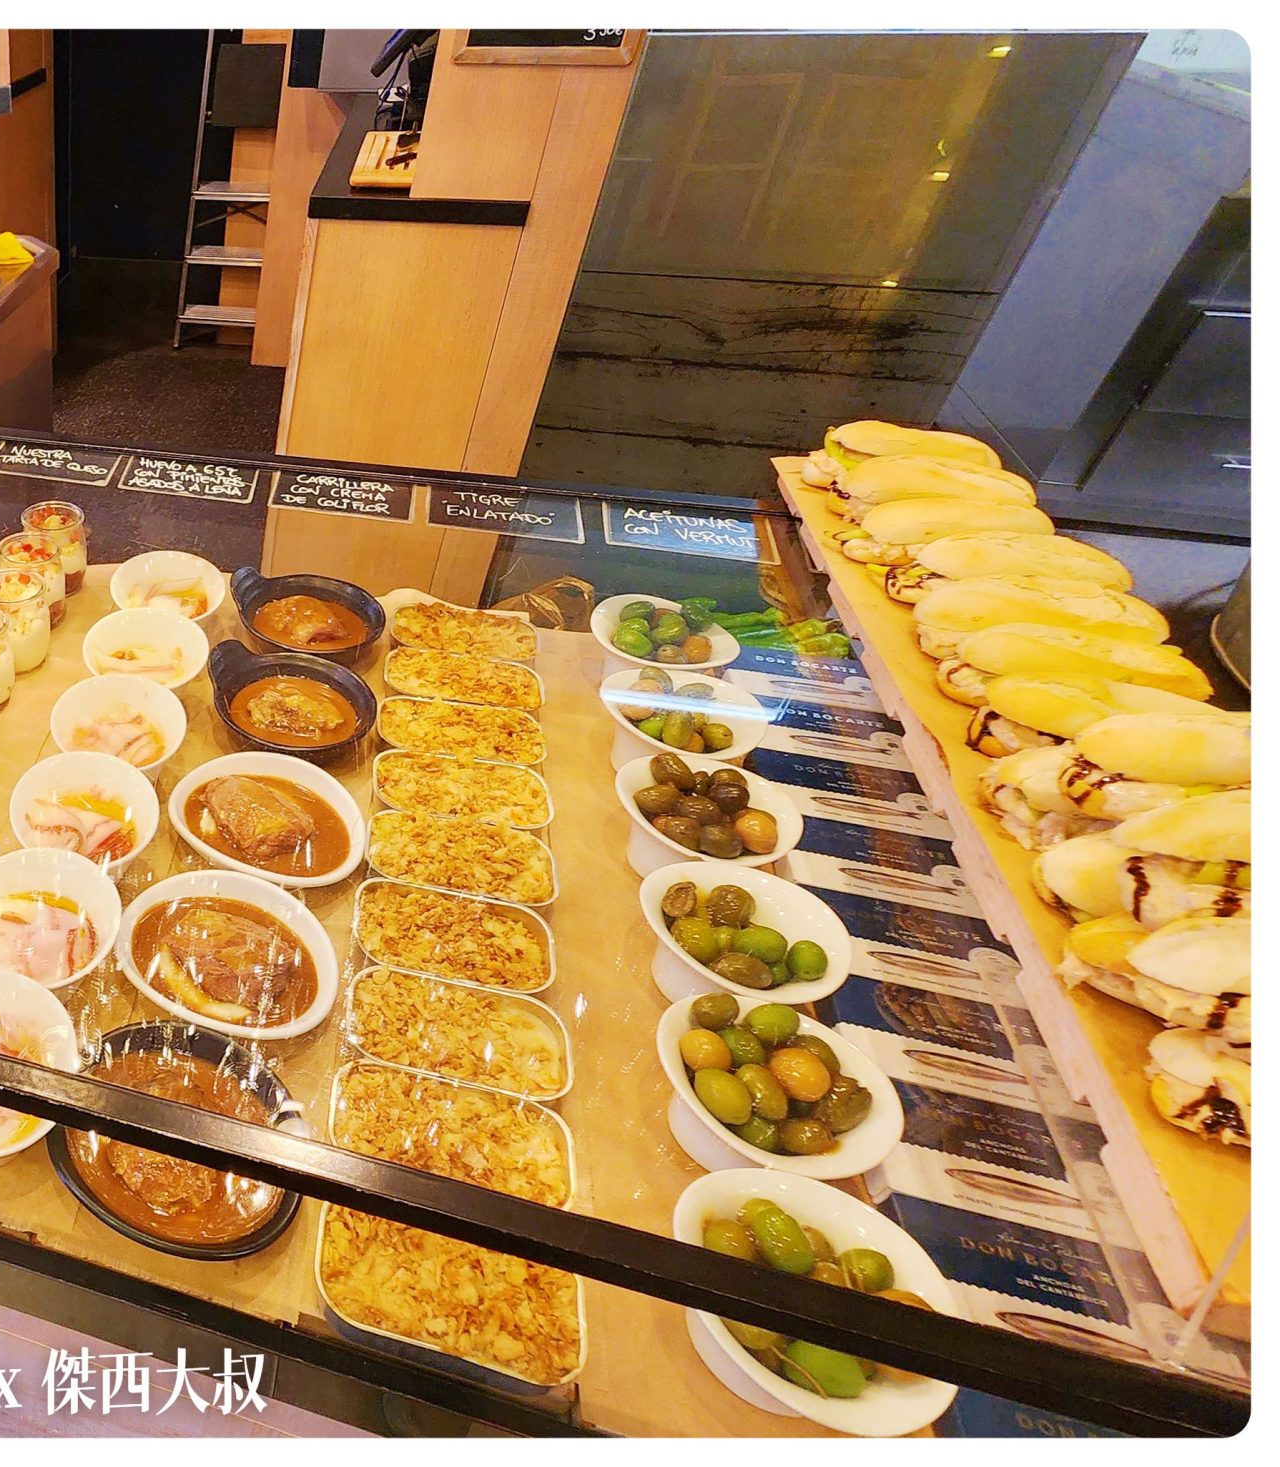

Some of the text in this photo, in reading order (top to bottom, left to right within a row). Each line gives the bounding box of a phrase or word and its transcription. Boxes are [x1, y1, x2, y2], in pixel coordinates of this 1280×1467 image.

[10, 445, 73, 460] NUESTRA
[0, 455, 108, 475] TARTA DE QUESO
[139, 457, 182, 471] HUEVO
[185, 464, 197, 473] A
[128, 476, 185, 491] ASADOS
[188, 483, 200, 492] A
[134, 468, 246, 488] CON PIMIENTOS
[296, 474, 395, 493] CARRILLERA
[280, 494, 307, 504] DE
[290, 484, 386, 502] CON CREMA
[453, 491, 523, 507] TIGRE
[624, 507, 748, 533] ACEITUNAS
[624, 522, 761, 549] CON VERMUT
[755, 655, 786, 665] DON
[791, 659, 858, 674] BOCARTE
[812, 711, 885, 729] BOCARTE
[793, 764, 828, 775] DON
[959, 1236, 1016, 1262] DON
